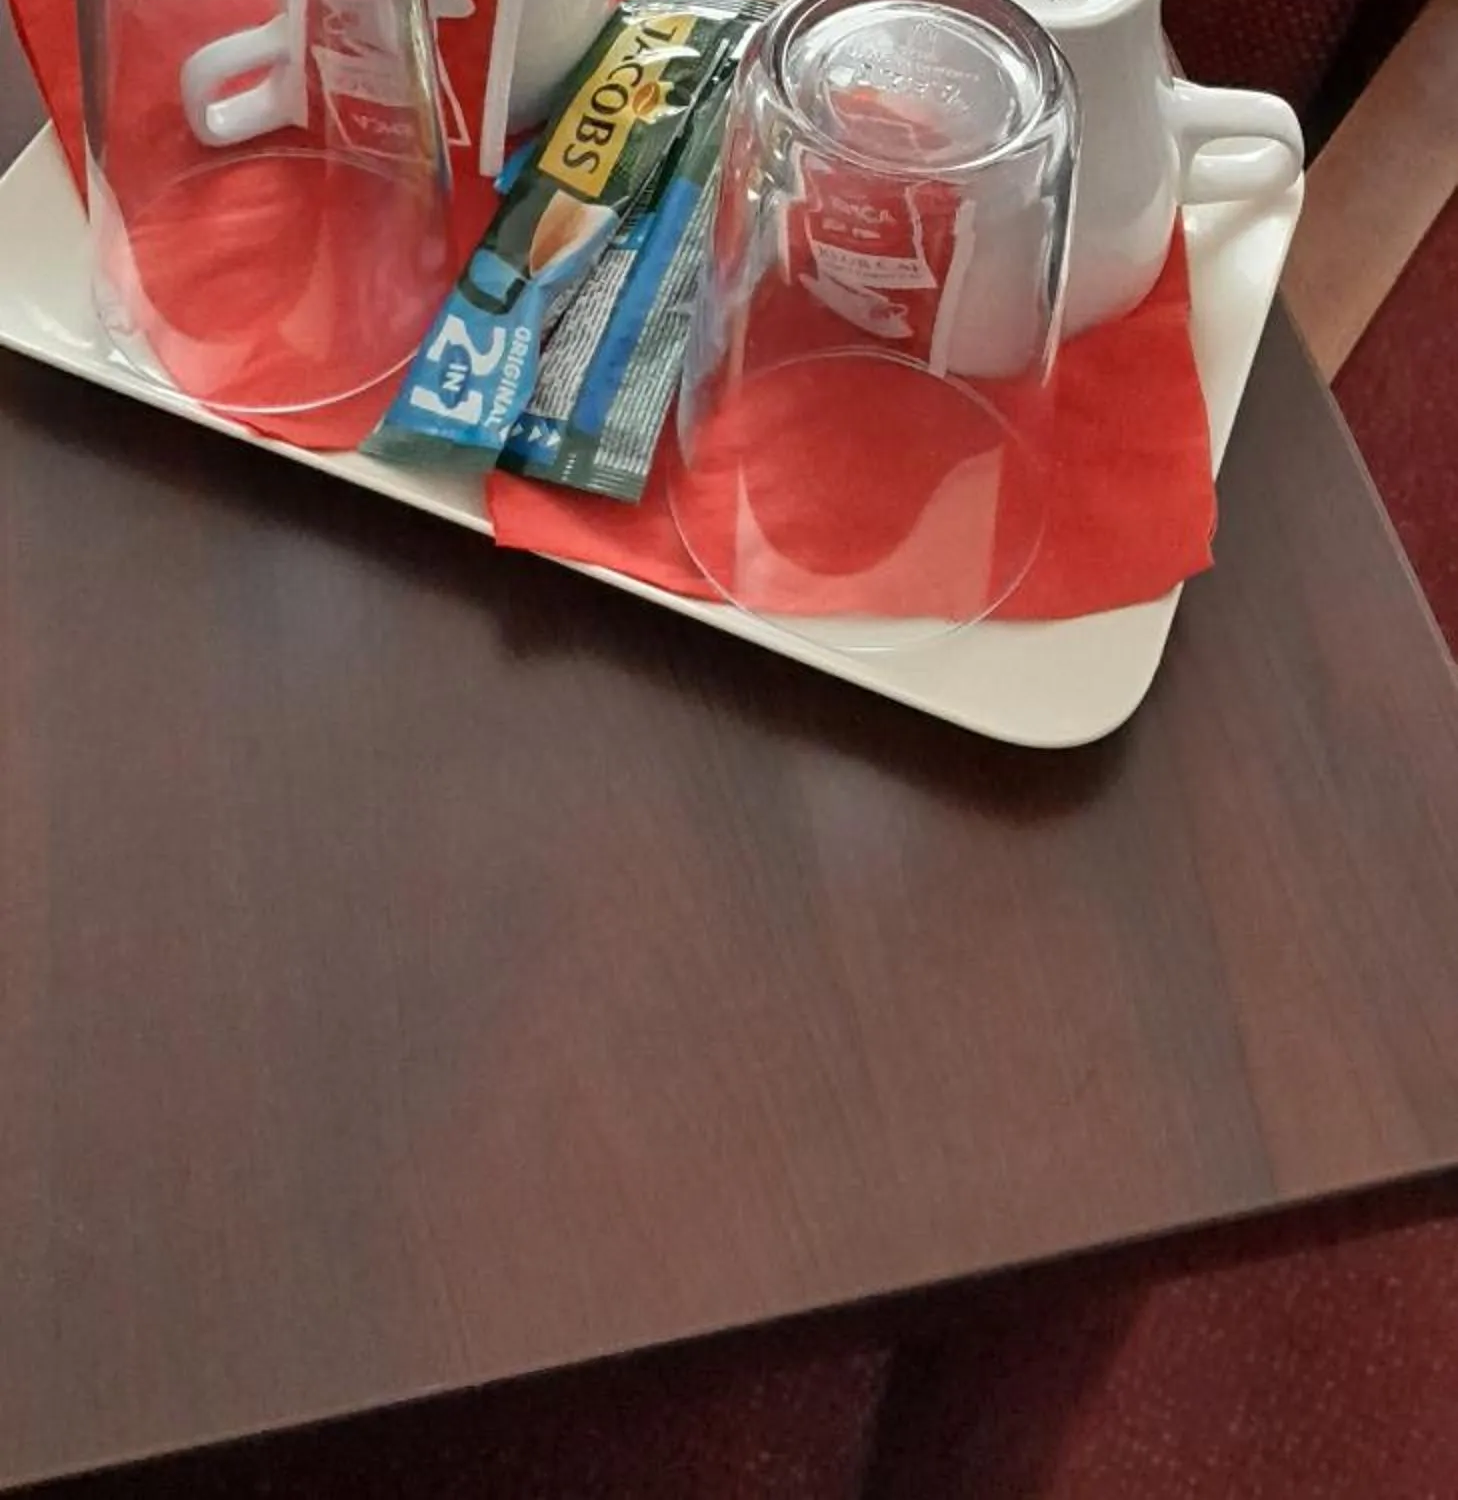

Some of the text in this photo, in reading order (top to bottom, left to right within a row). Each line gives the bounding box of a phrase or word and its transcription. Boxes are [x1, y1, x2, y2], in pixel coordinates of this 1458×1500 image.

[563, 19, 679, 175] JACOBS
[426, 313, 507, 377] 2
[441, 362, 468, 393] IN
[483, 326, 532, 427] ORIGINAL
